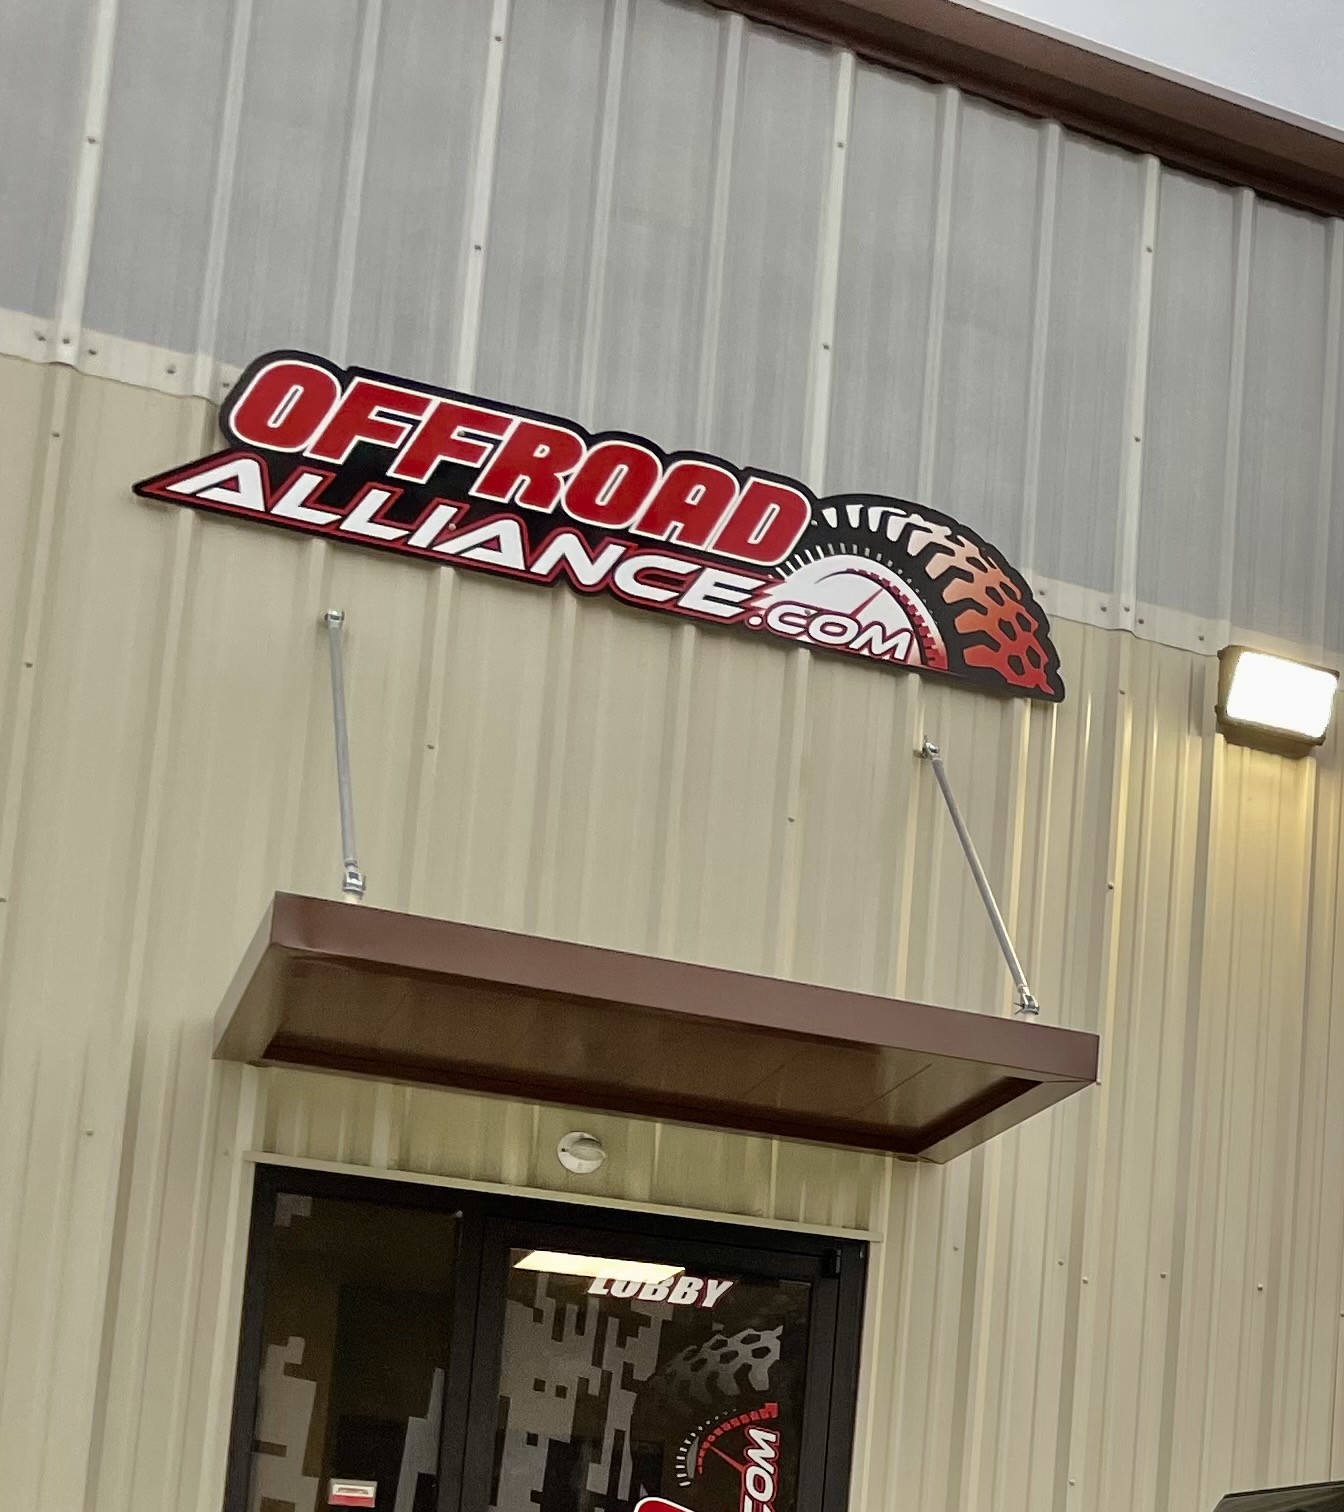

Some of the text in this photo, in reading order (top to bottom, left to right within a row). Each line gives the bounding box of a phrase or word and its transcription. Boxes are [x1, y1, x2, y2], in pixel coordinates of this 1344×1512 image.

[160, 453, 918, 665] ALLIANCE.COM
[228, 358, 814, 567] OFFROAD
[587, 1275, 734, 1308] LOBBY
